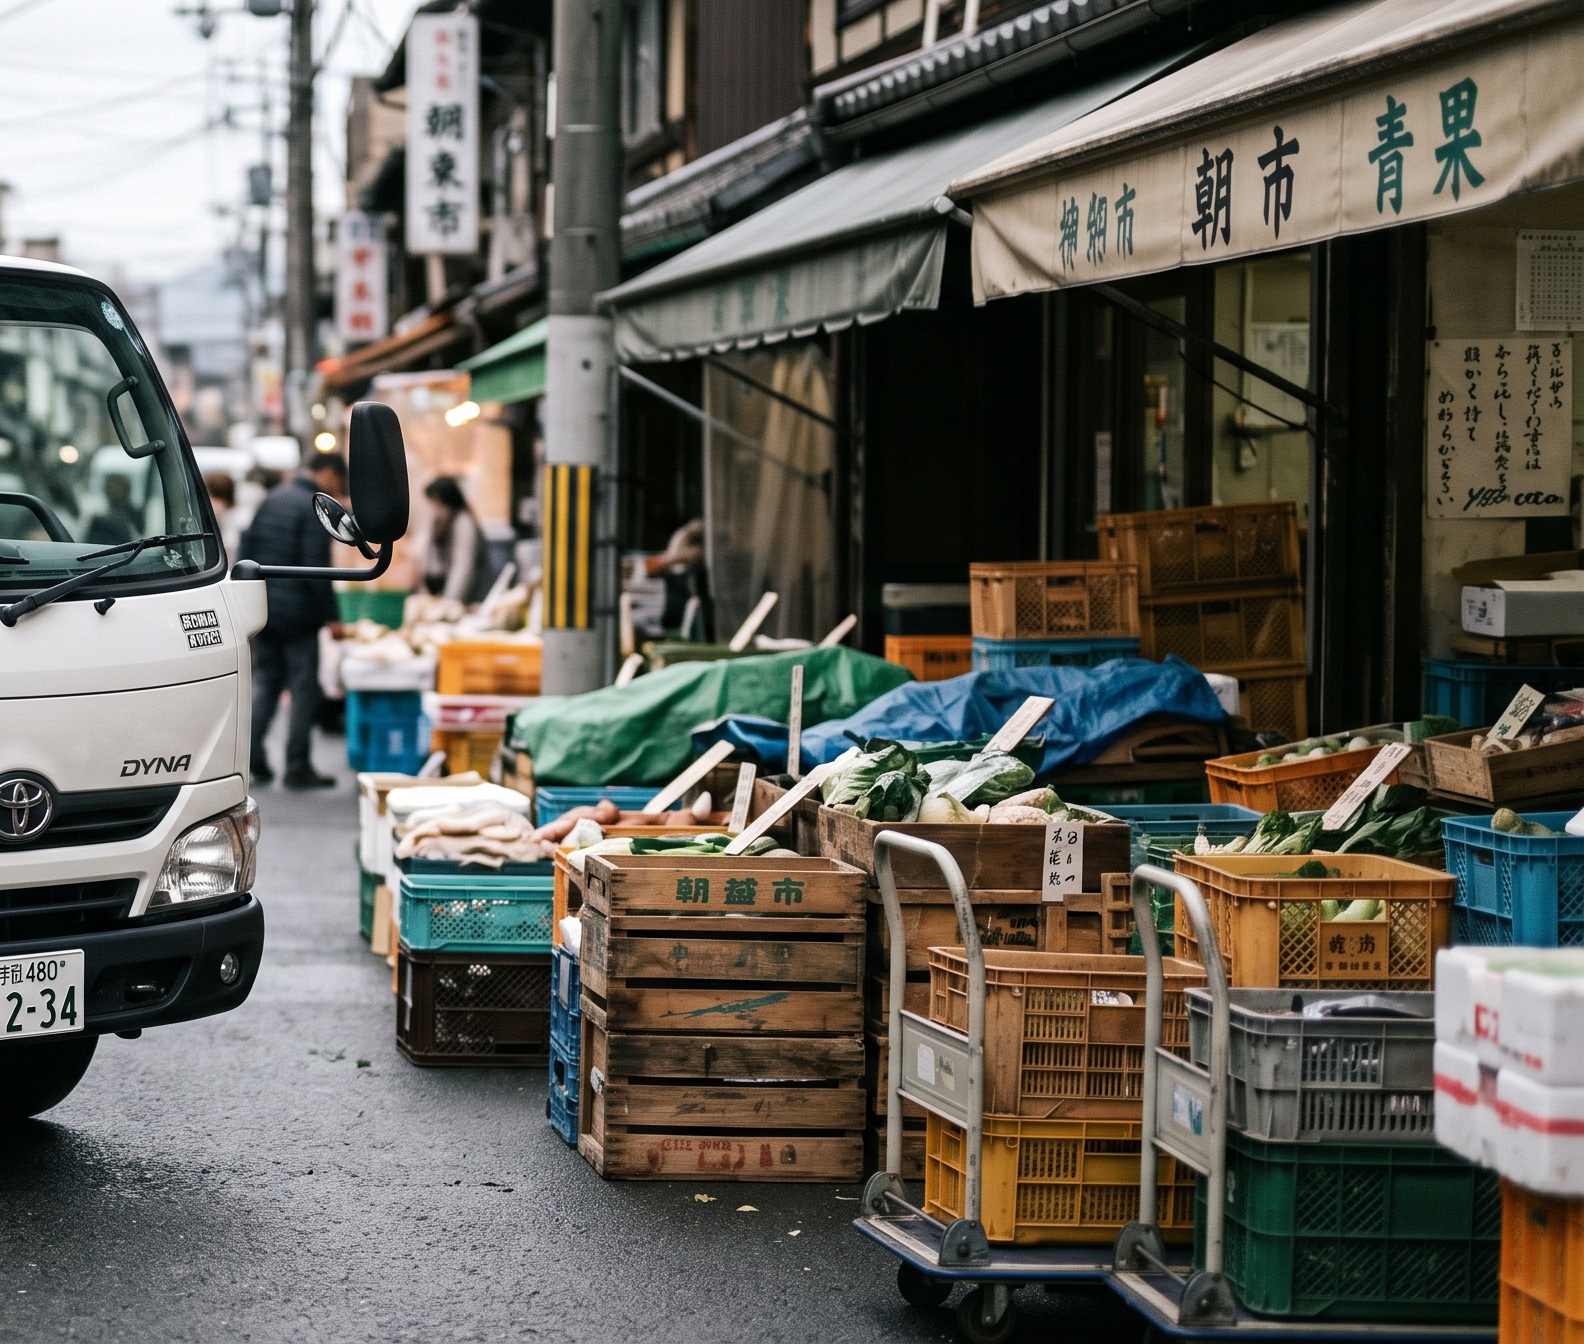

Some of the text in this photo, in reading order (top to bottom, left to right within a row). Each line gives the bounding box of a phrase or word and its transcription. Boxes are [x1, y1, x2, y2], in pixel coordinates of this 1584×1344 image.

[1191, 125, 1300, 251] 朝市
[1367, 76, 1486, 216] 青果
[120, 754, 192, 778] DYNA
